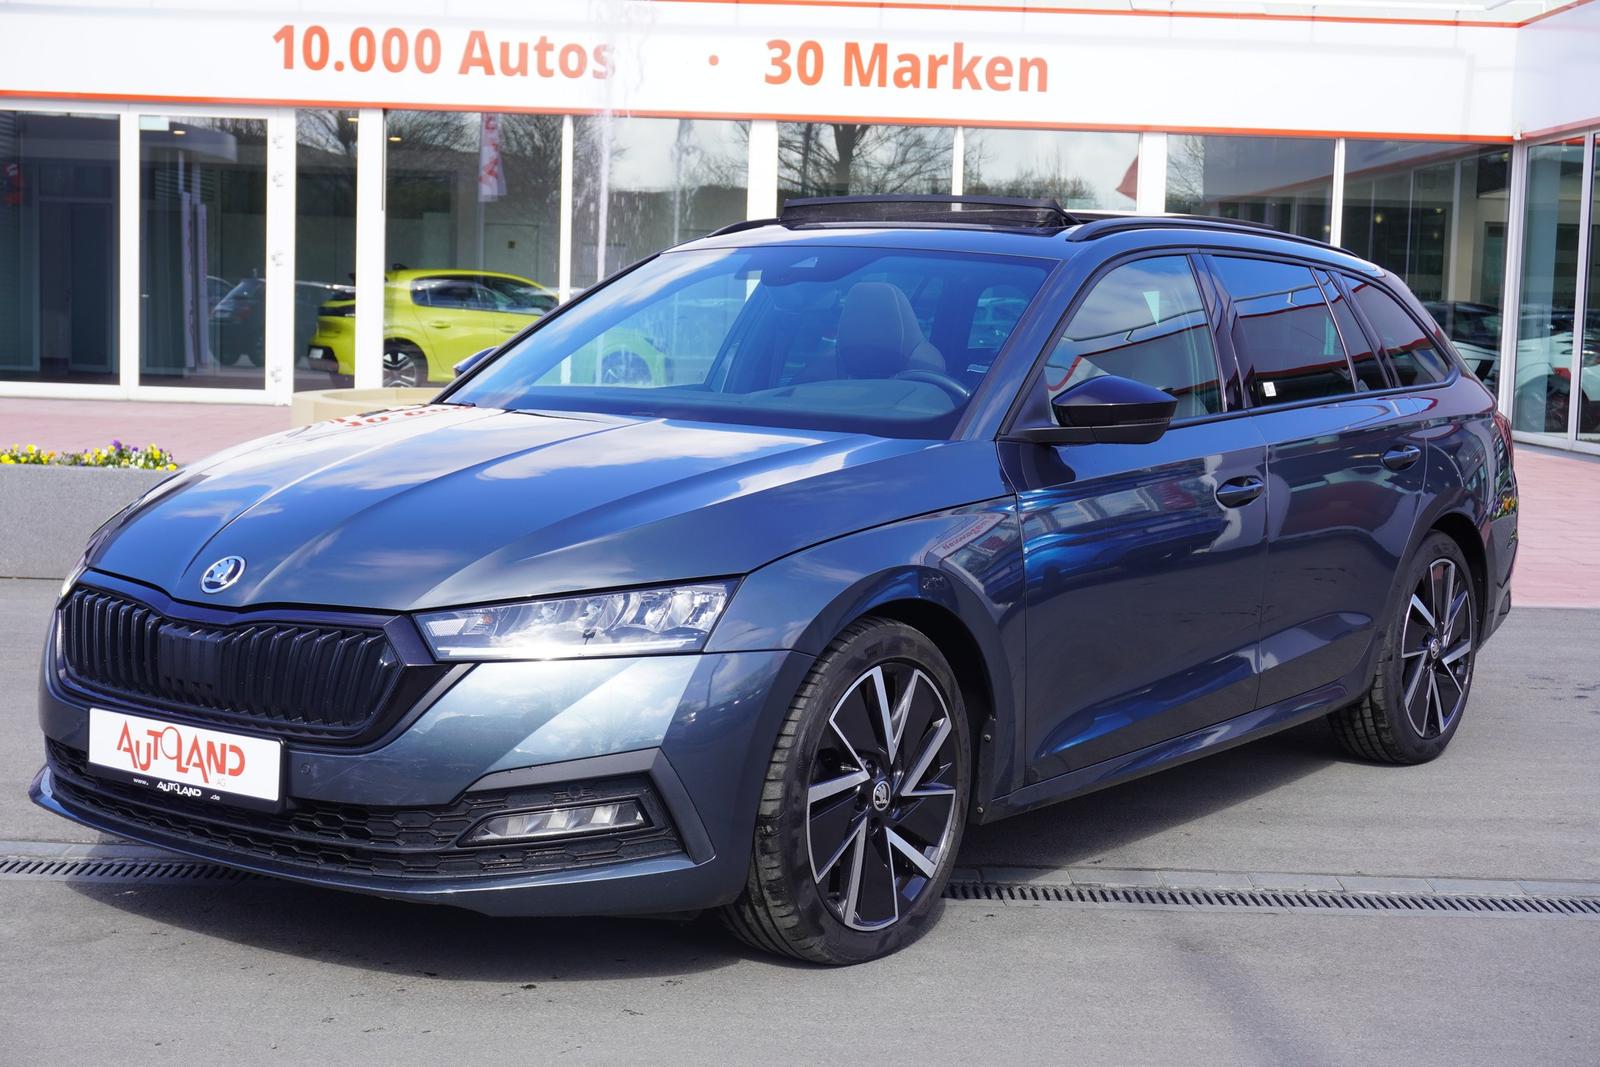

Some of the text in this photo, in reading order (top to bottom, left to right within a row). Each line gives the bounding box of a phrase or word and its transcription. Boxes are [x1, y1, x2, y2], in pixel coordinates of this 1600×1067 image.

[273, 24, 1049, 93] 10.000 Autos 30 Marken
